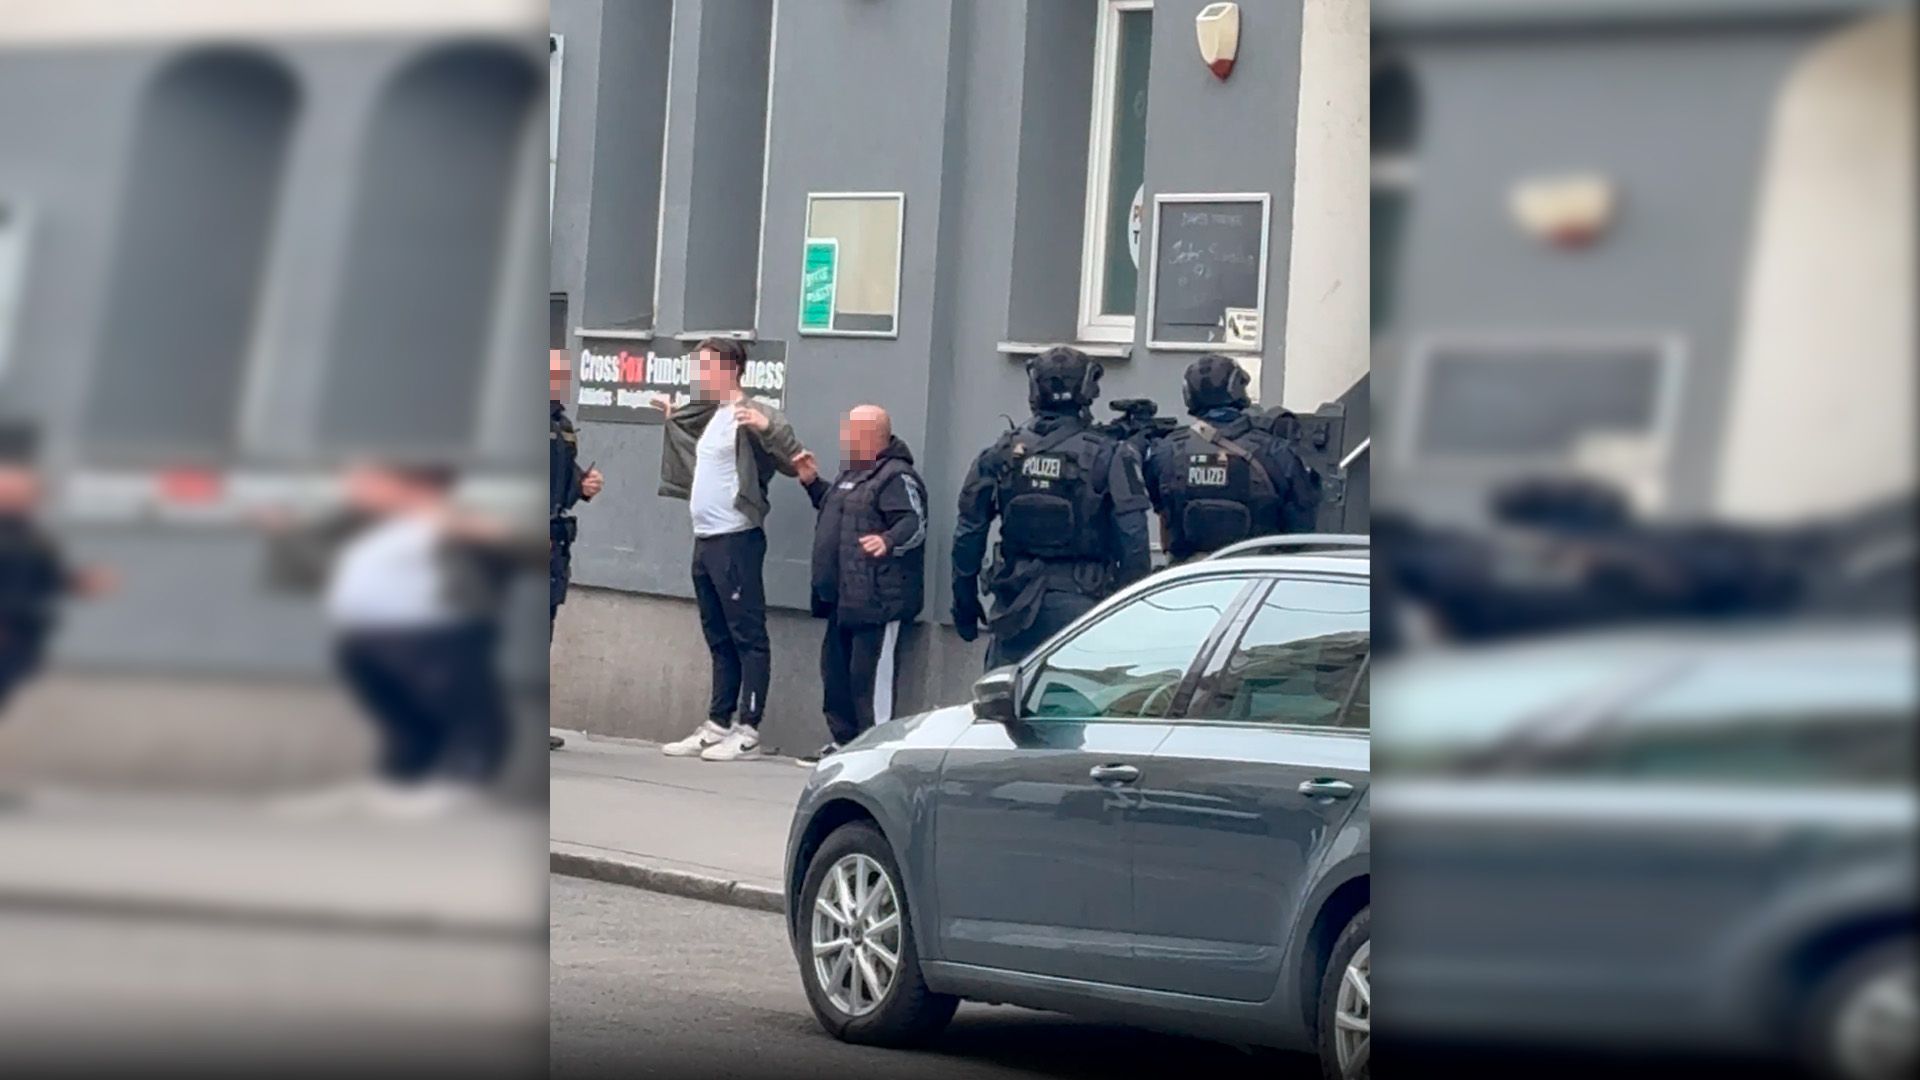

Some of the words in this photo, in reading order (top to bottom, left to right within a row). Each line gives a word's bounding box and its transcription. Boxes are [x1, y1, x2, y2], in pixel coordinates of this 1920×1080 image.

[580, 349, 643, 383] CrossFox
[1022, 457, 1060, 477] POLIZEI
[1189, 467, 1226, 485] POLIZEI
